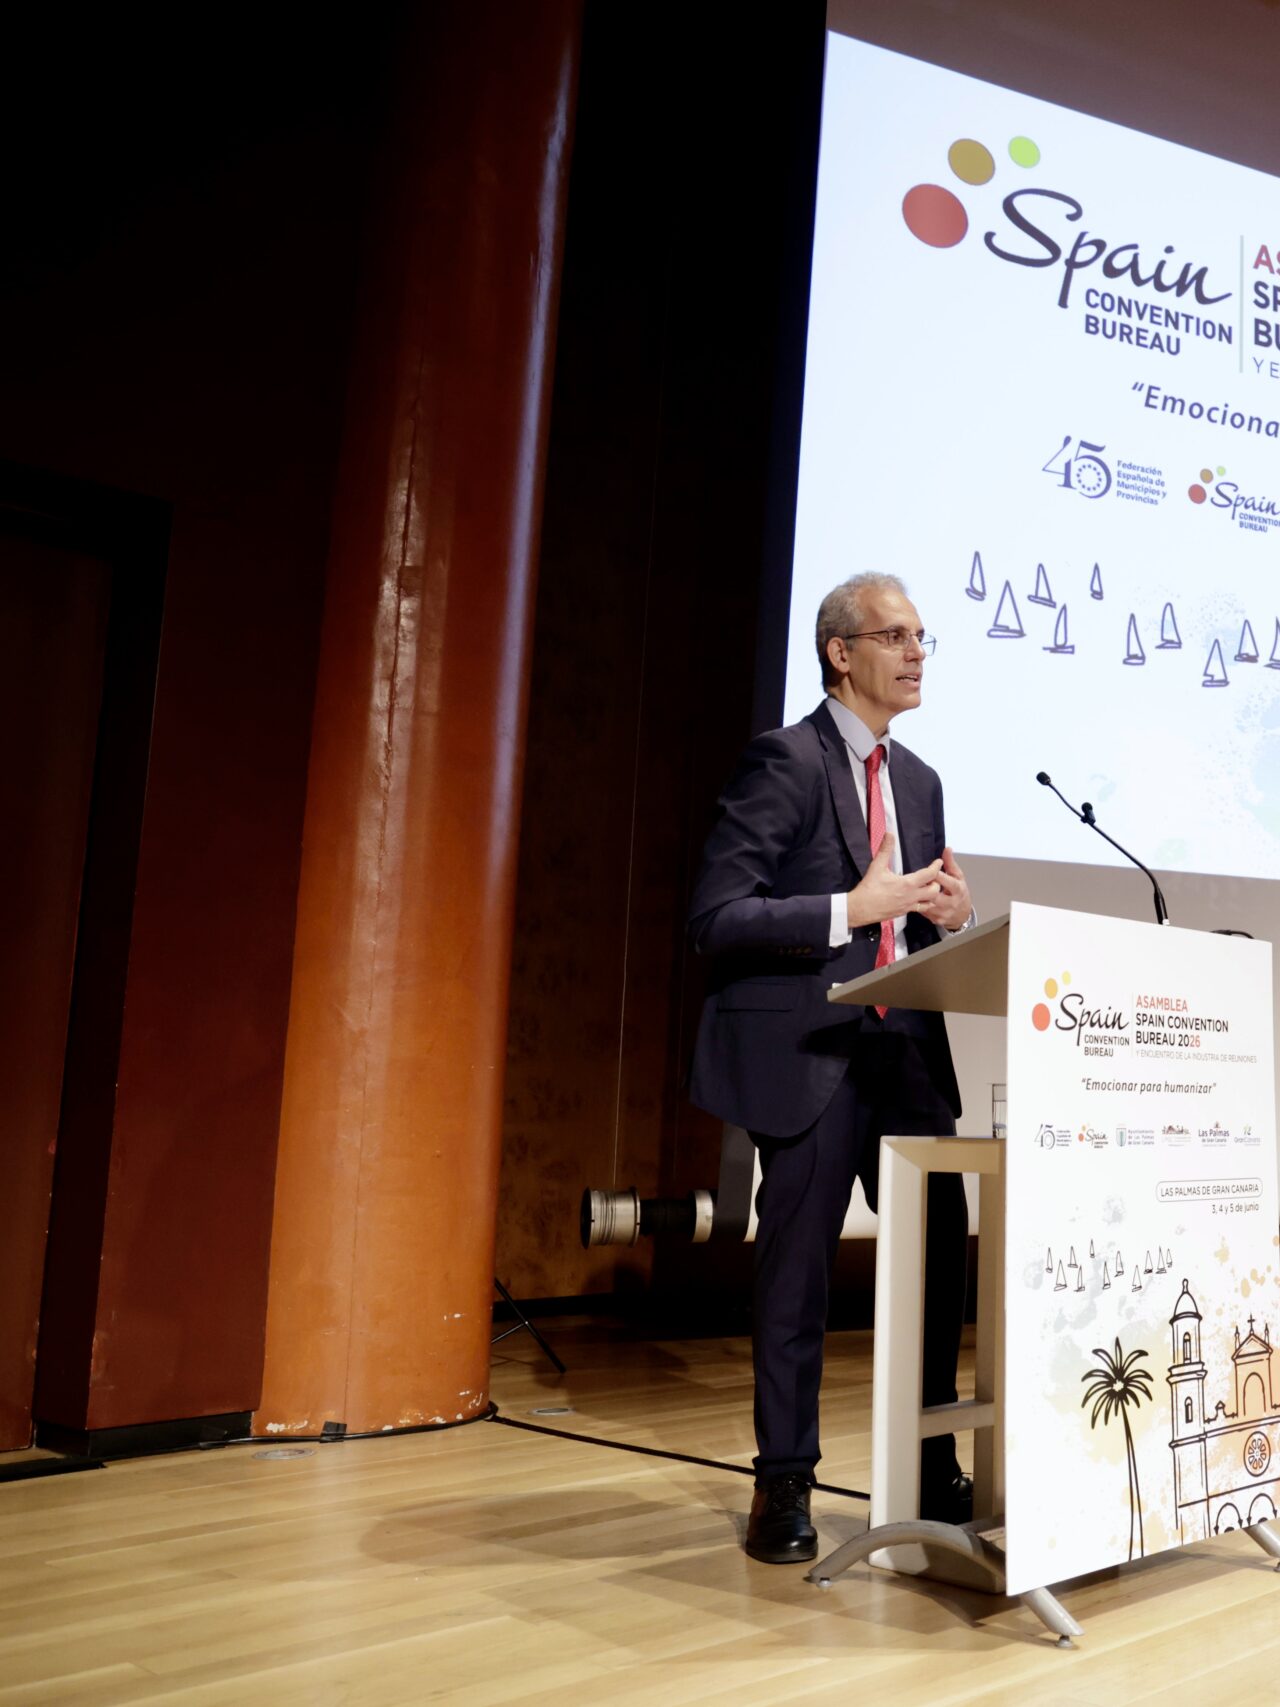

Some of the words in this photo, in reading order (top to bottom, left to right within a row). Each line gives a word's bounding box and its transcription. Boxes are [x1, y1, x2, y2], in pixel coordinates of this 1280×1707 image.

[984, 188, 1232, 309] Spain
[1085, 288, 1233, 344] CONVENTION
[1085, 314, 1181, 355] BUREAU
[1252, 357, 1264, 374] Y
[1042, 435, 1112, 499] 45
[1117, 460, 1162, 477] Federación
[1117, 470, 1153, 485] Española
[1155, 478, 1165, 488] de
[1116, 480, 1160, 496] Municipios
[1162, 490, 1167, 498] y
[1116, 490, 1159, 506] Provincias
[1239, 521, 1268, 533] BUREAU
[1136, 994, 1188, 1012] ASAMBLEA
[1055, 993, 1129, 1047] Spain
[1136, 1013, 1165, 1028] SPAIN
[1167, 1015, 1229, 1032] CONVENTION
[1084, 1034, 1130, 1046] CONVENTION
[1136, 1031, 1175, 1046] BUREAU
[1178, 1034, 1201, 1048] 2026
[1084, 1047, 1114, 1057] BUREAU
[1141, 1049, 1174, 1059] ENCUENTRO
[1176, 1051, 1183, 1060] DE
[1184, 1052, 1191, 1060] LA
[1192, 1053, 1219, 1061] INDUSTRIA
[1220, 1054, 1228, 1062] DE
[1228, 1054, 1257, 1063] REUNIONES
[1140, 1082, 1161, 1095] para
[1198, 1129, 1208, 1137] Las
[1209, 1128, 1230, 1137] Palmas
[1161, 1187, 1173, 1197] LAS
[1175, 1186, 1200, 1197] PALMAS
[1202, 1185, 1210, 1195] DE
[1212, 1185, 1230, 1194] GRAN
[1231, 1184, 1259, 1194] CANARIA
[1212, 1204, 1218, 1215] 3,
[1219, 1203, 1223, 1213] 4
[1225, 1205, 1229, 1215] y
[1229, 1203, 1234, 1213] 5
[1235, 1202, 1243, 1212] de
[1244, 1202, 1260, 1214] junio
